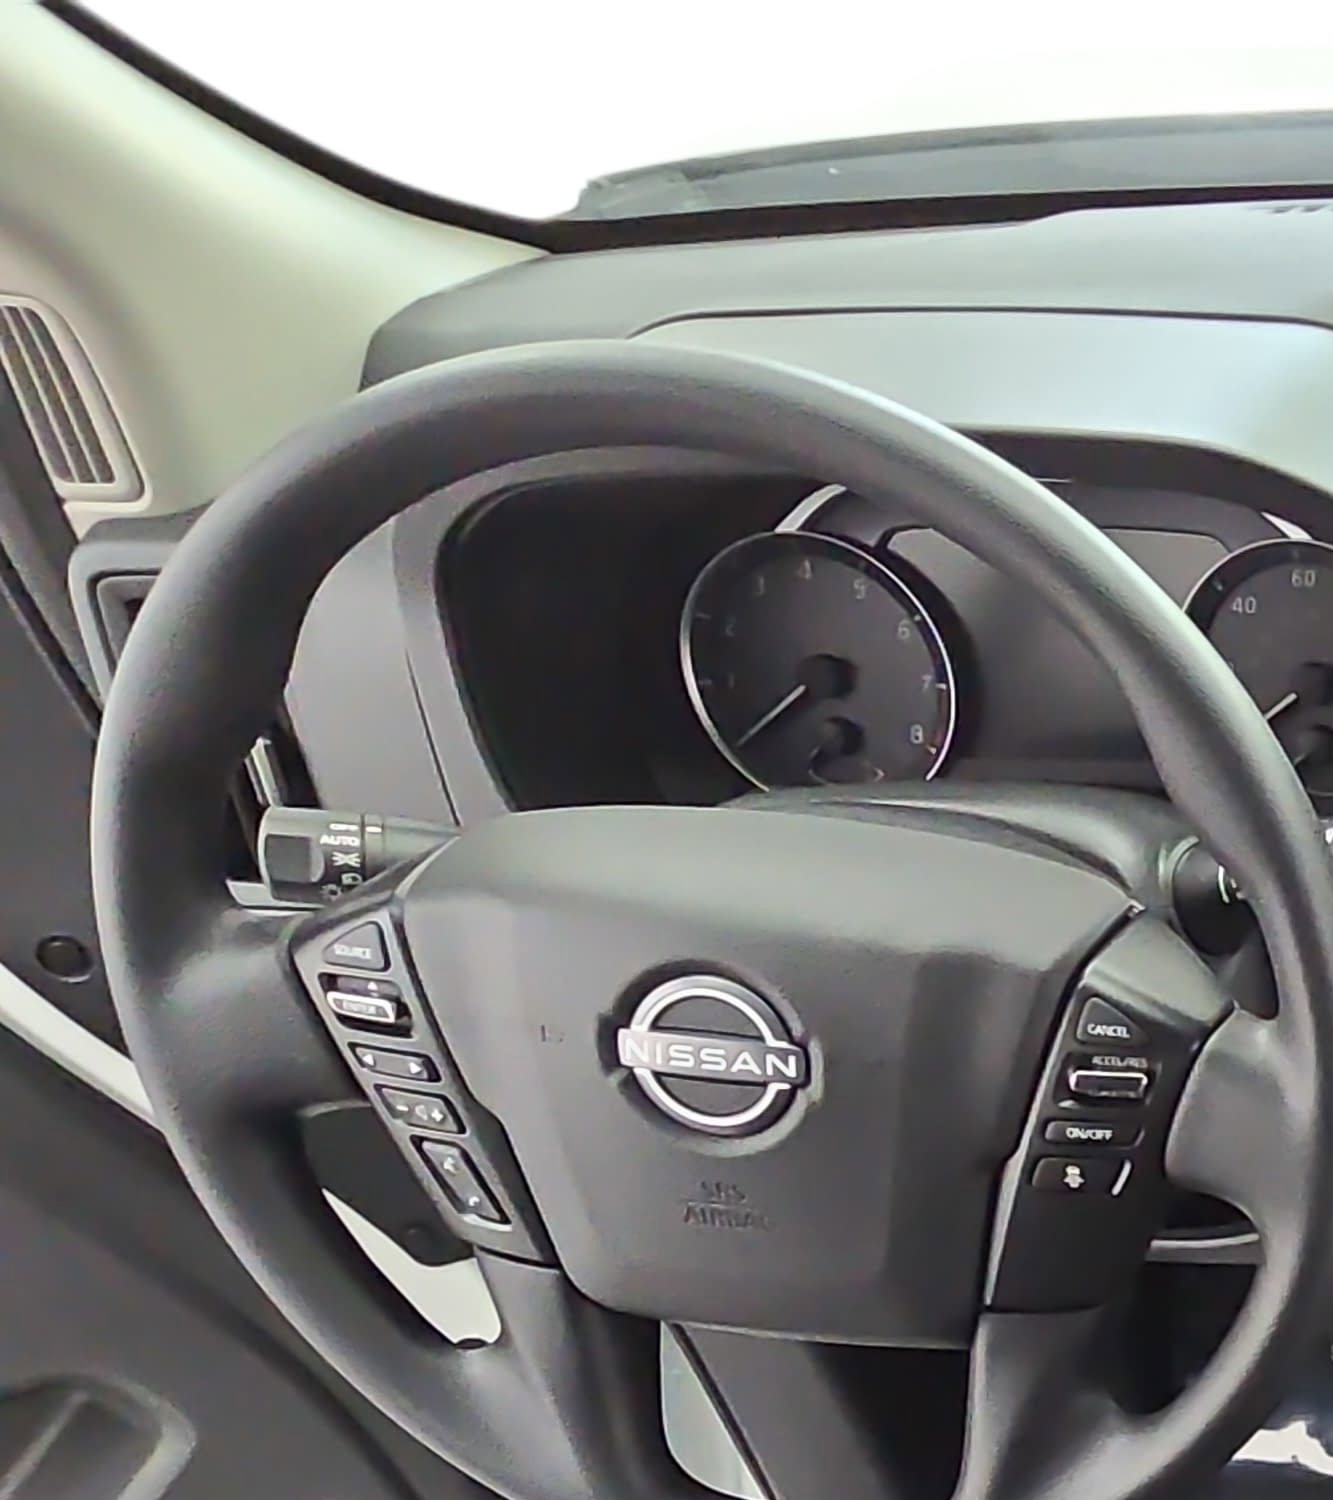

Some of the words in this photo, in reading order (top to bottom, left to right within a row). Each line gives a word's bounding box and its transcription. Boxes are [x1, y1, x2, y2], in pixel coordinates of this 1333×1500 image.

[1290, 568, 1317, 588] 60
[1231, 596, 1258, 615] 40
[898, 618, 910, 640] 6
[921, 673, 932, 691] 7
[910, 723, 924, 745] 8
[319, 833, 361, 847] AUTO
[1086, 1022, 1131, 1039] CANCEL
[623, 1036, 798, 1080] NISSAN
[1065, 1126, 1113, 1141] ON/OFF
